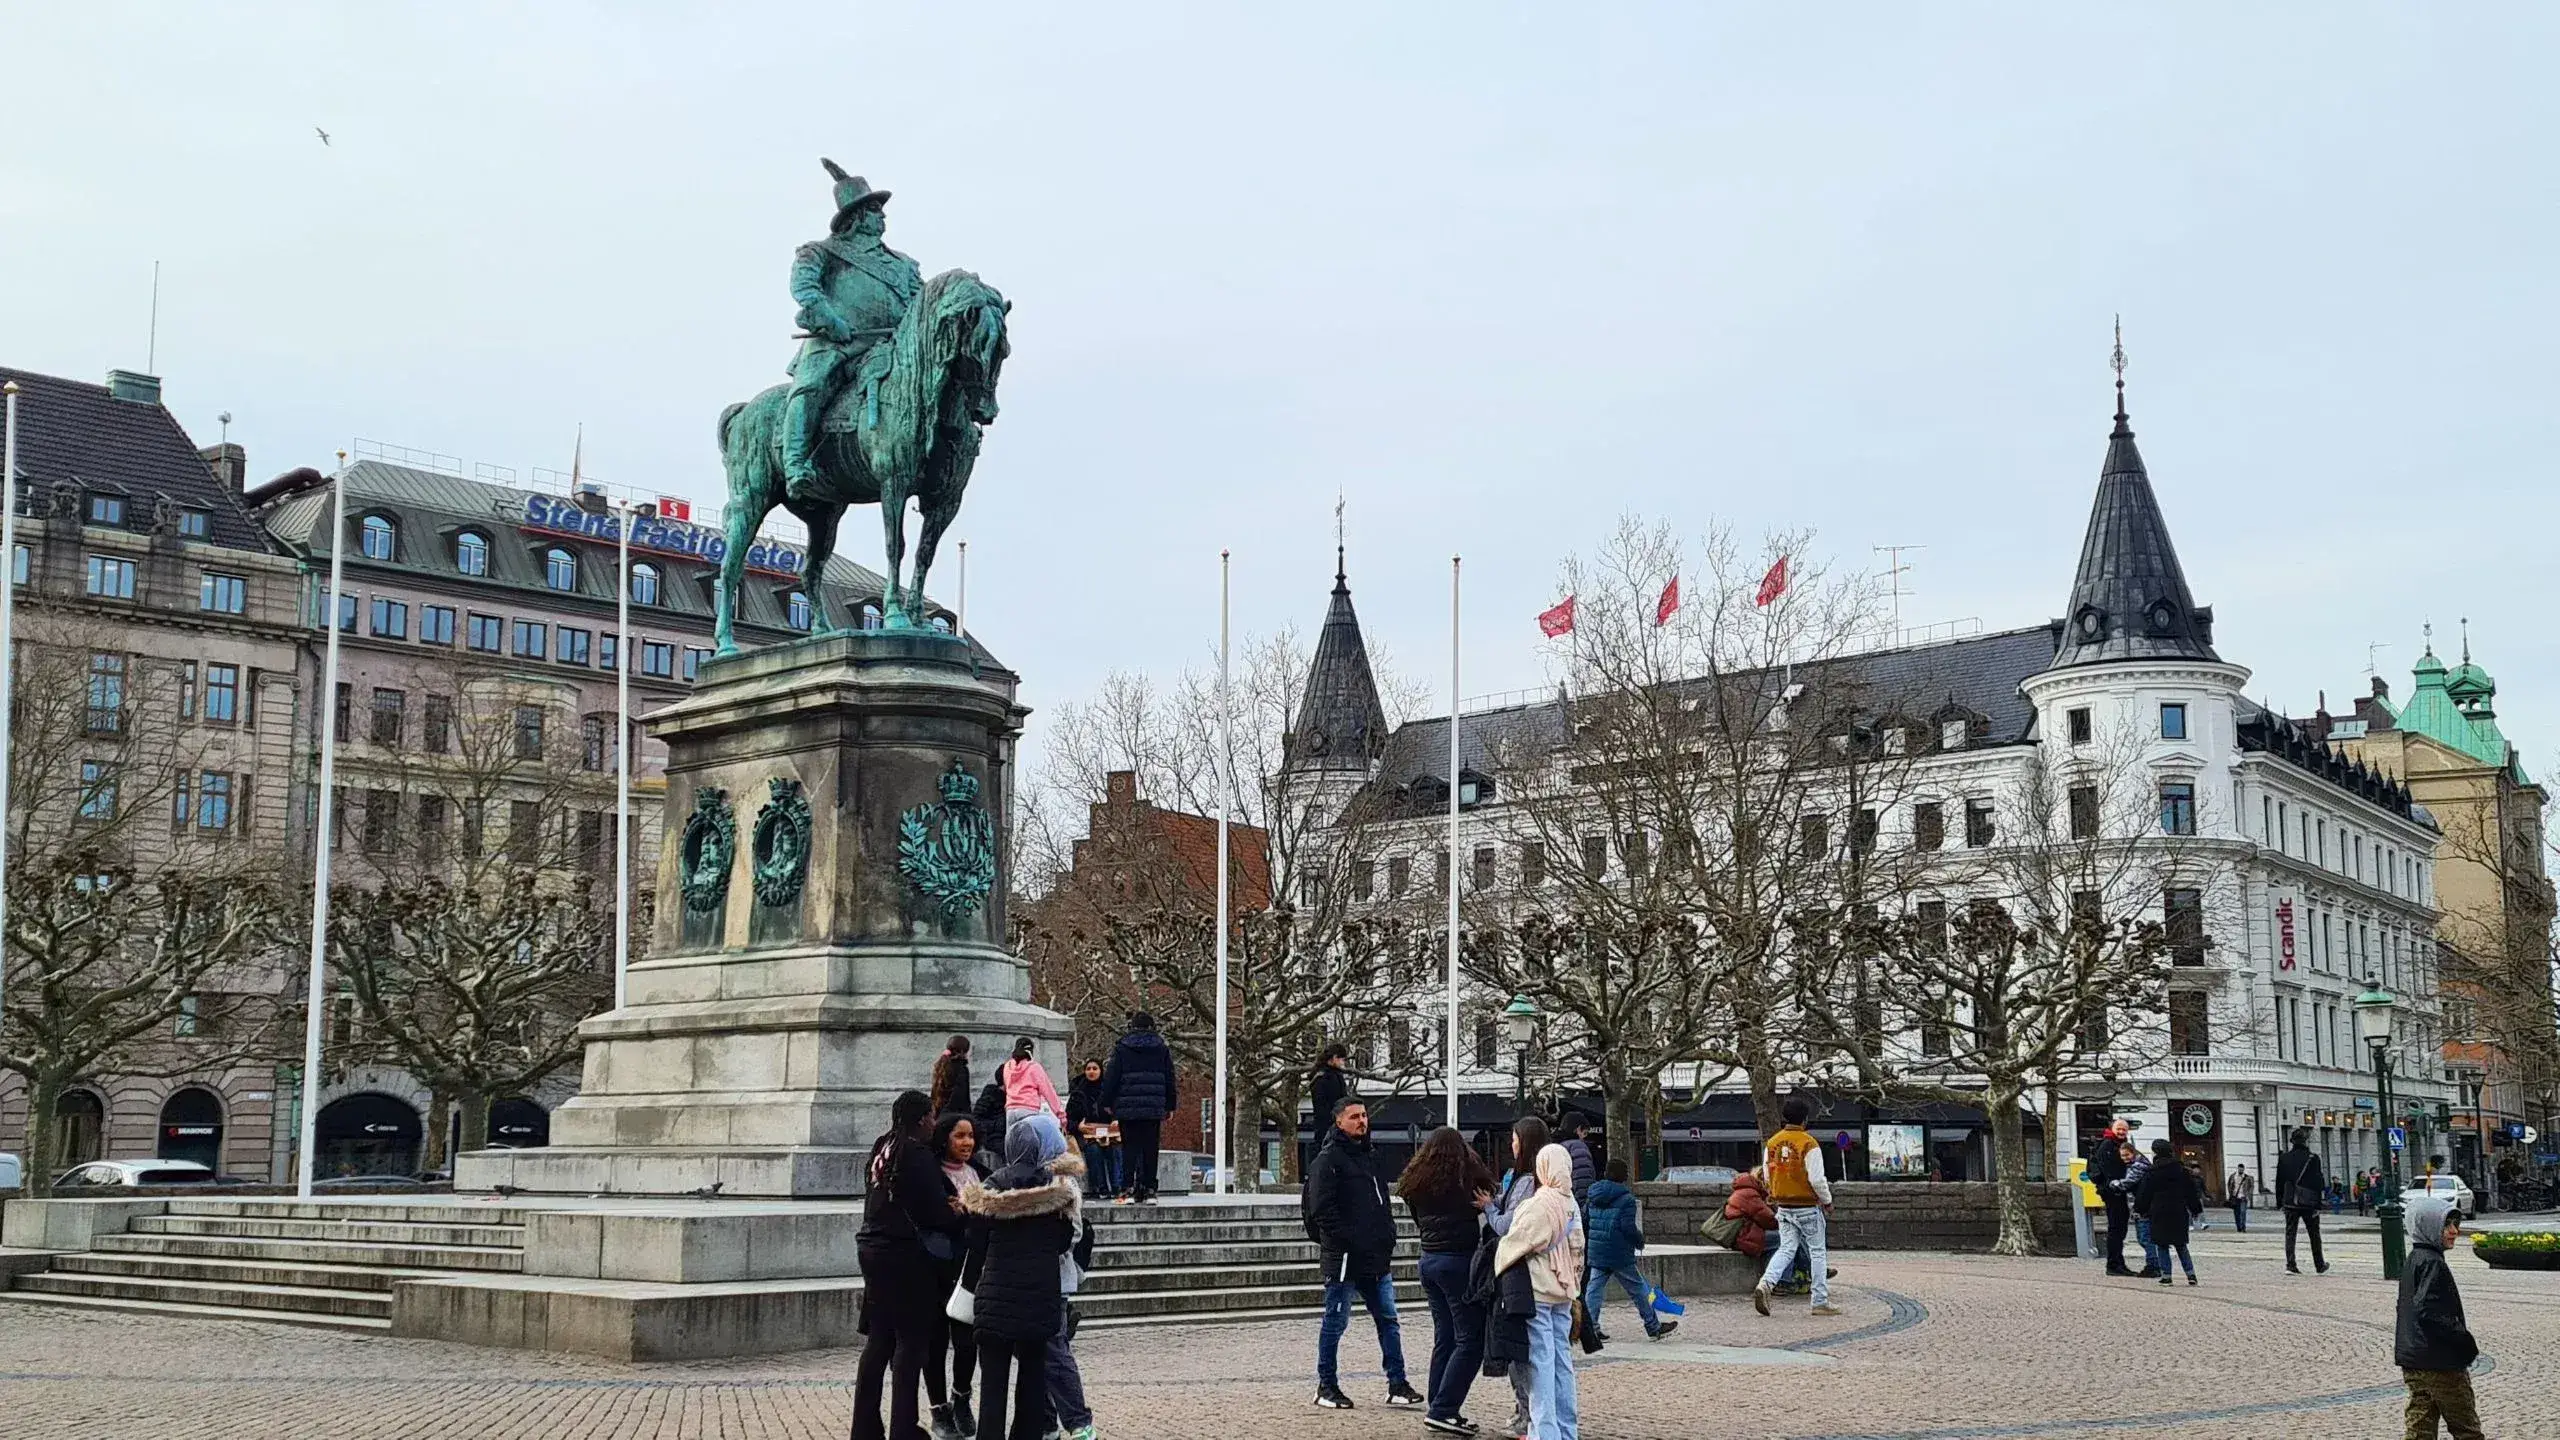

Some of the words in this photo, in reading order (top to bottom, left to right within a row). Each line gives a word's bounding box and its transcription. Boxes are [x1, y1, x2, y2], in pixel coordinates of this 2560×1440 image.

[525, 494, 621, 541] Stena
[628, 514, 804, 572] Fastigete
[2276, 897, 2296, 971] Scandic
